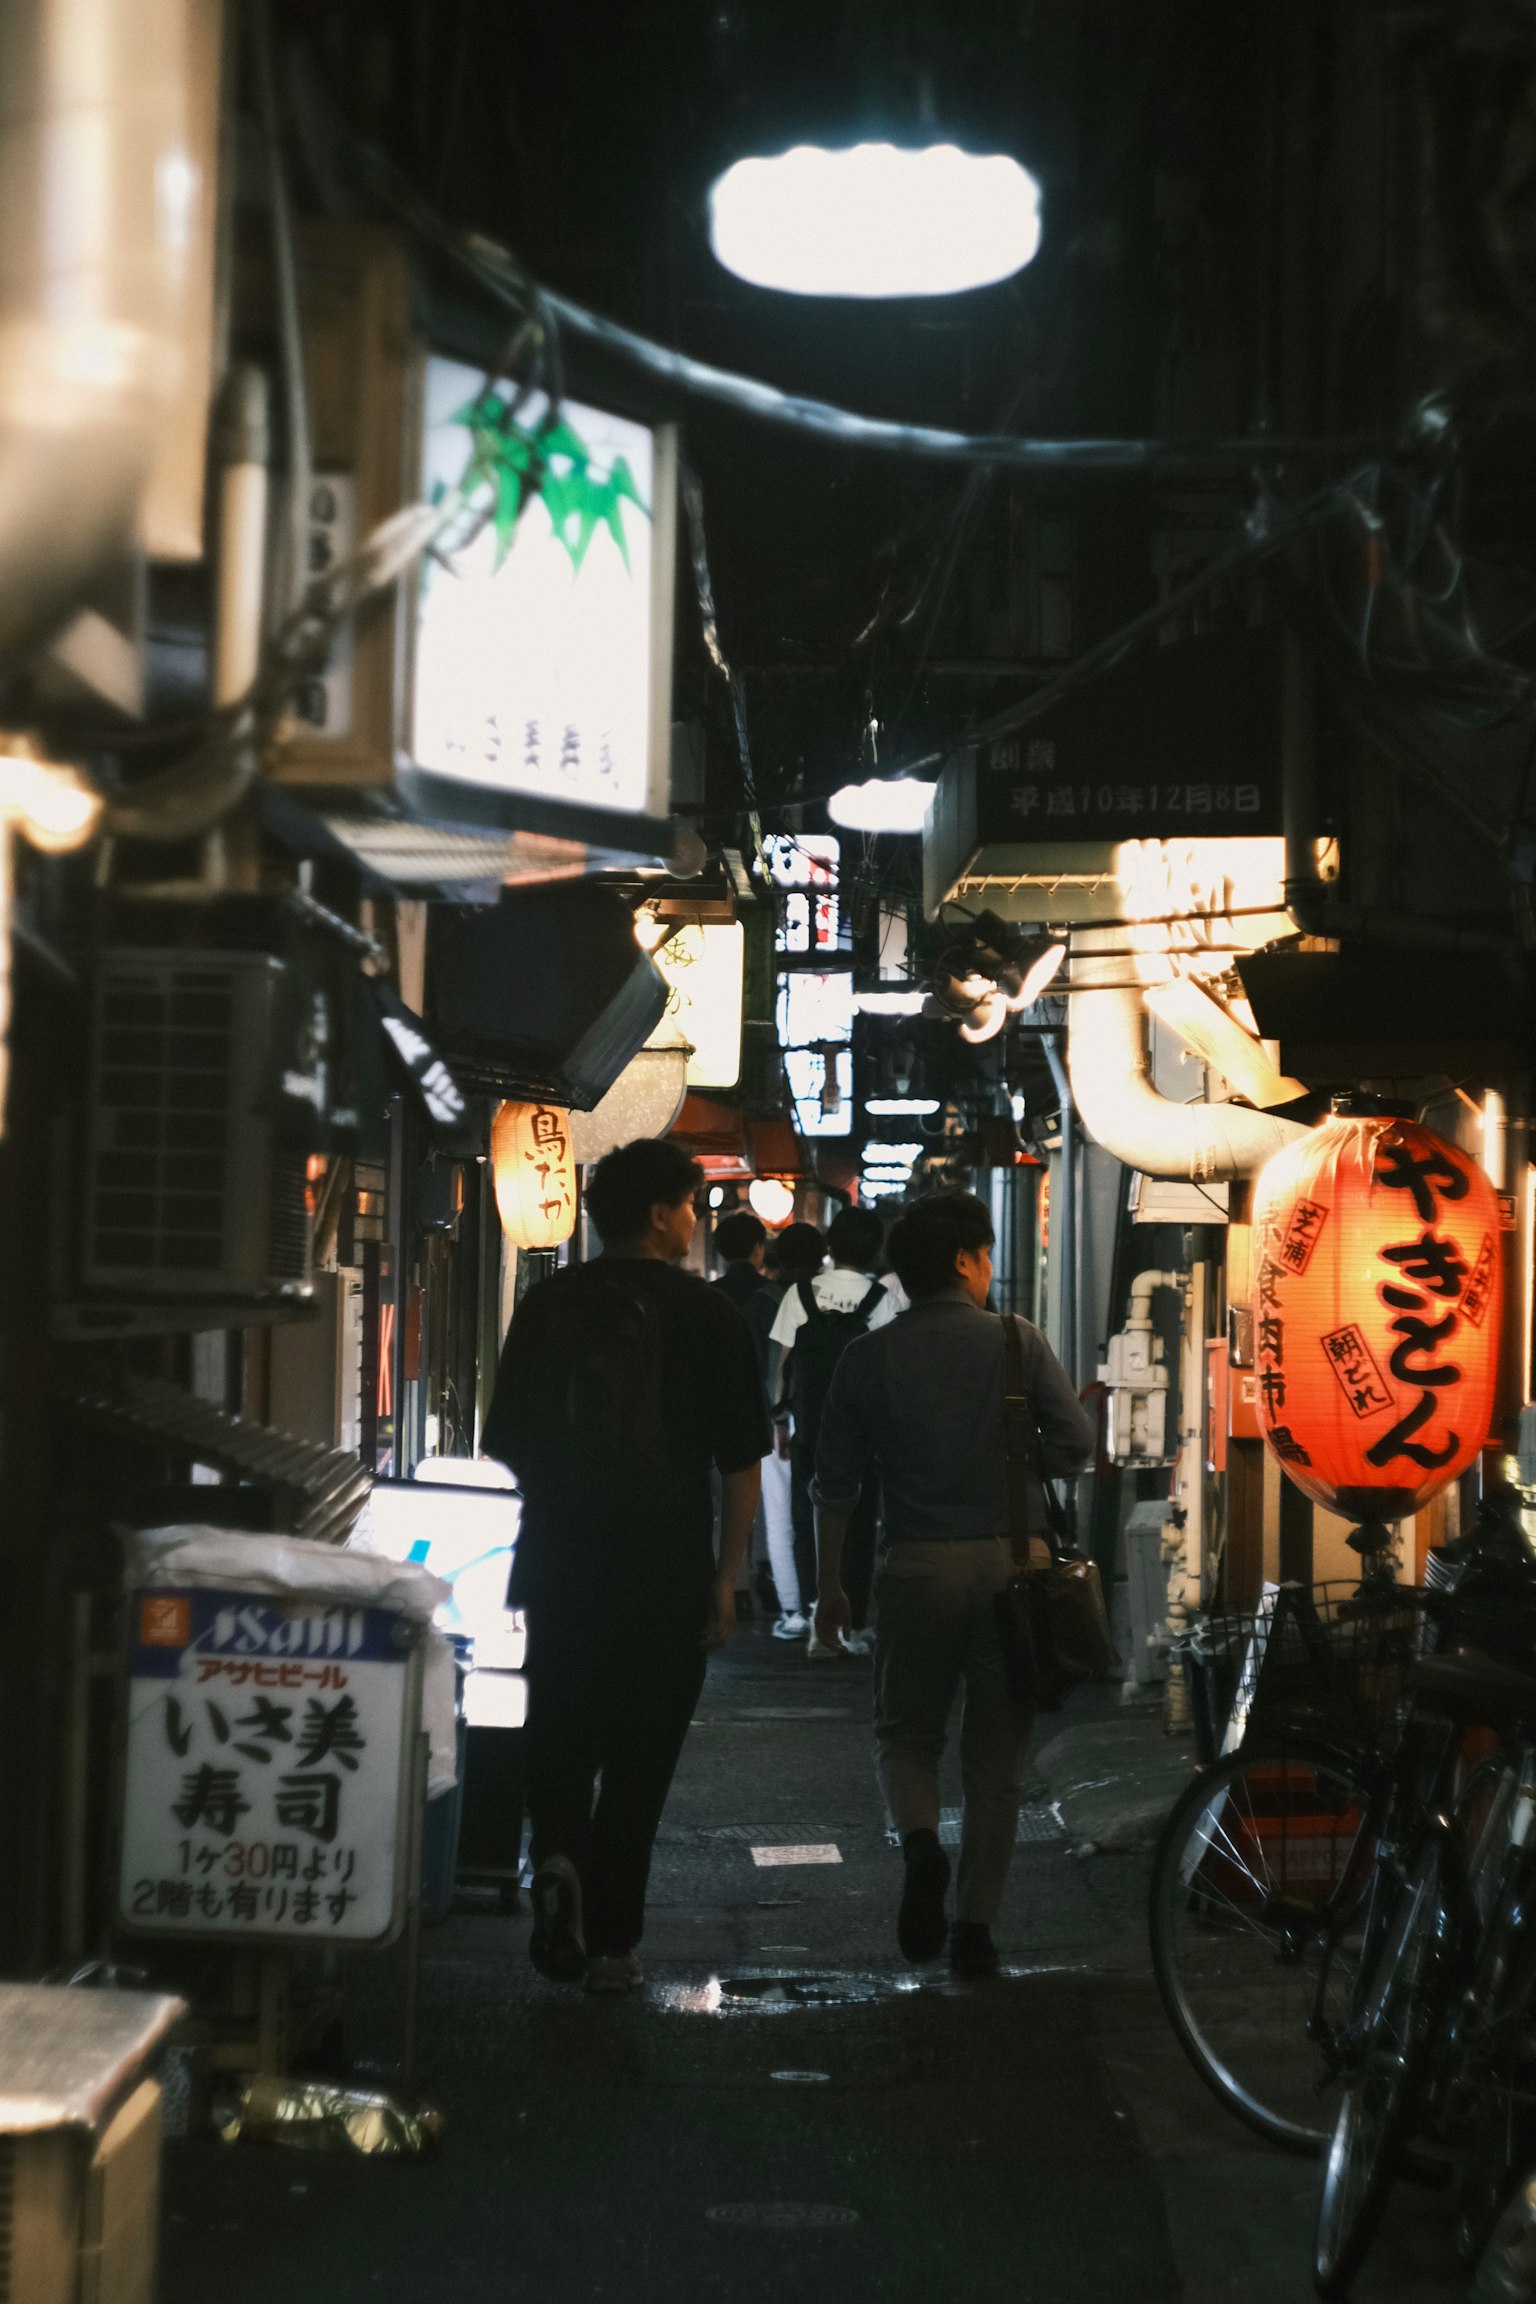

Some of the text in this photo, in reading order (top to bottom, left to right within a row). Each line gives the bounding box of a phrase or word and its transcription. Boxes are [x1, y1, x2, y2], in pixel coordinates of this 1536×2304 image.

[1010, 783, 1261, 816] 平成10年12月8日
[1281, 1203, 1322, 1270] 芝浦
[1366, 1147, 1470, 1470] やきとん
[1327, 1328, 1387, 1413] 朝どれ
[196, 1659, 349, 1690] アサヒビール
[164, 1694, 366, 1772] いさ美
[170, 1763, 343, 1843] 寿司
[132, 1877, 358, 1926] 2階も有ります
